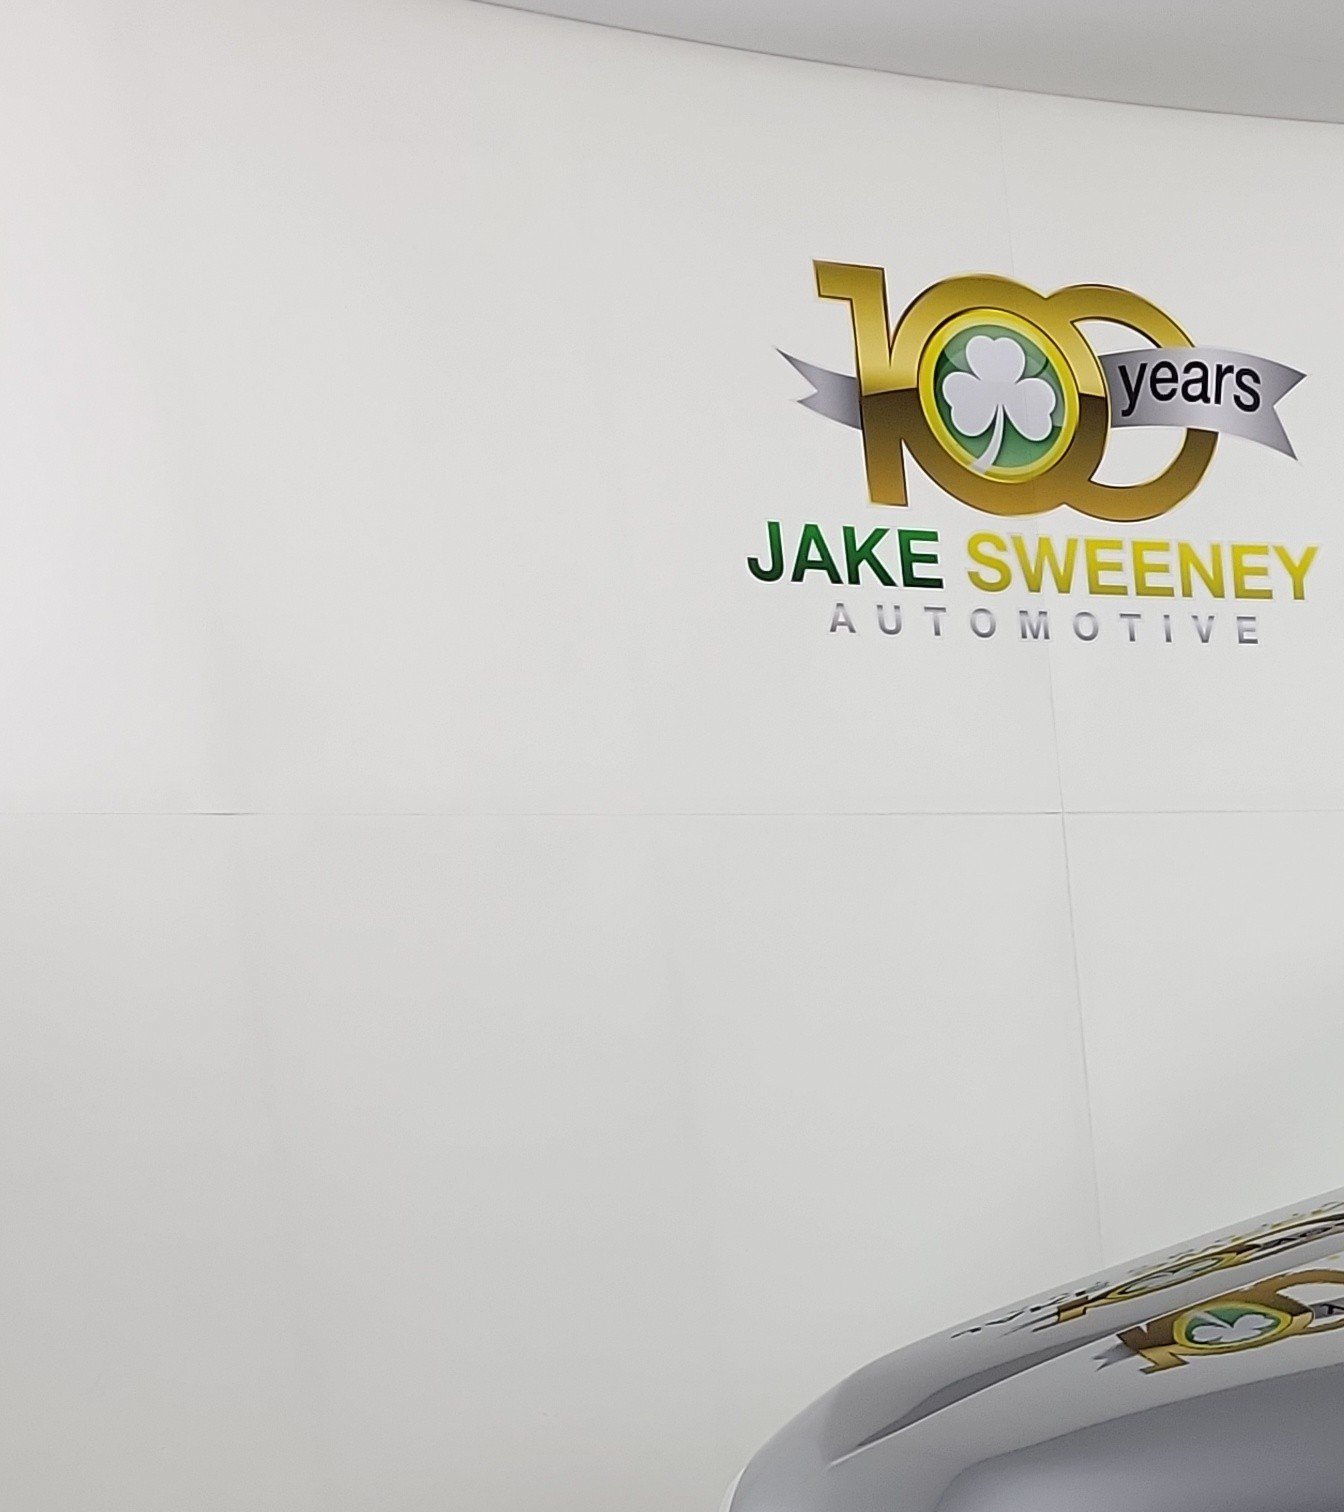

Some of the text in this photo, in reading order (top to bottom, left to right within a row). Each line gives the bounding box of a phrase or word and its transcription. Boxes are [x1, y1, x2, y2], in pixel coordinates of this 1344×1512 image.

[812, 258, 1262, 524] 100 years
[746, 520, 1321, 601] JAKE SWEENEY
[829, 602, 1260, 646] AUTOMOTIVE
